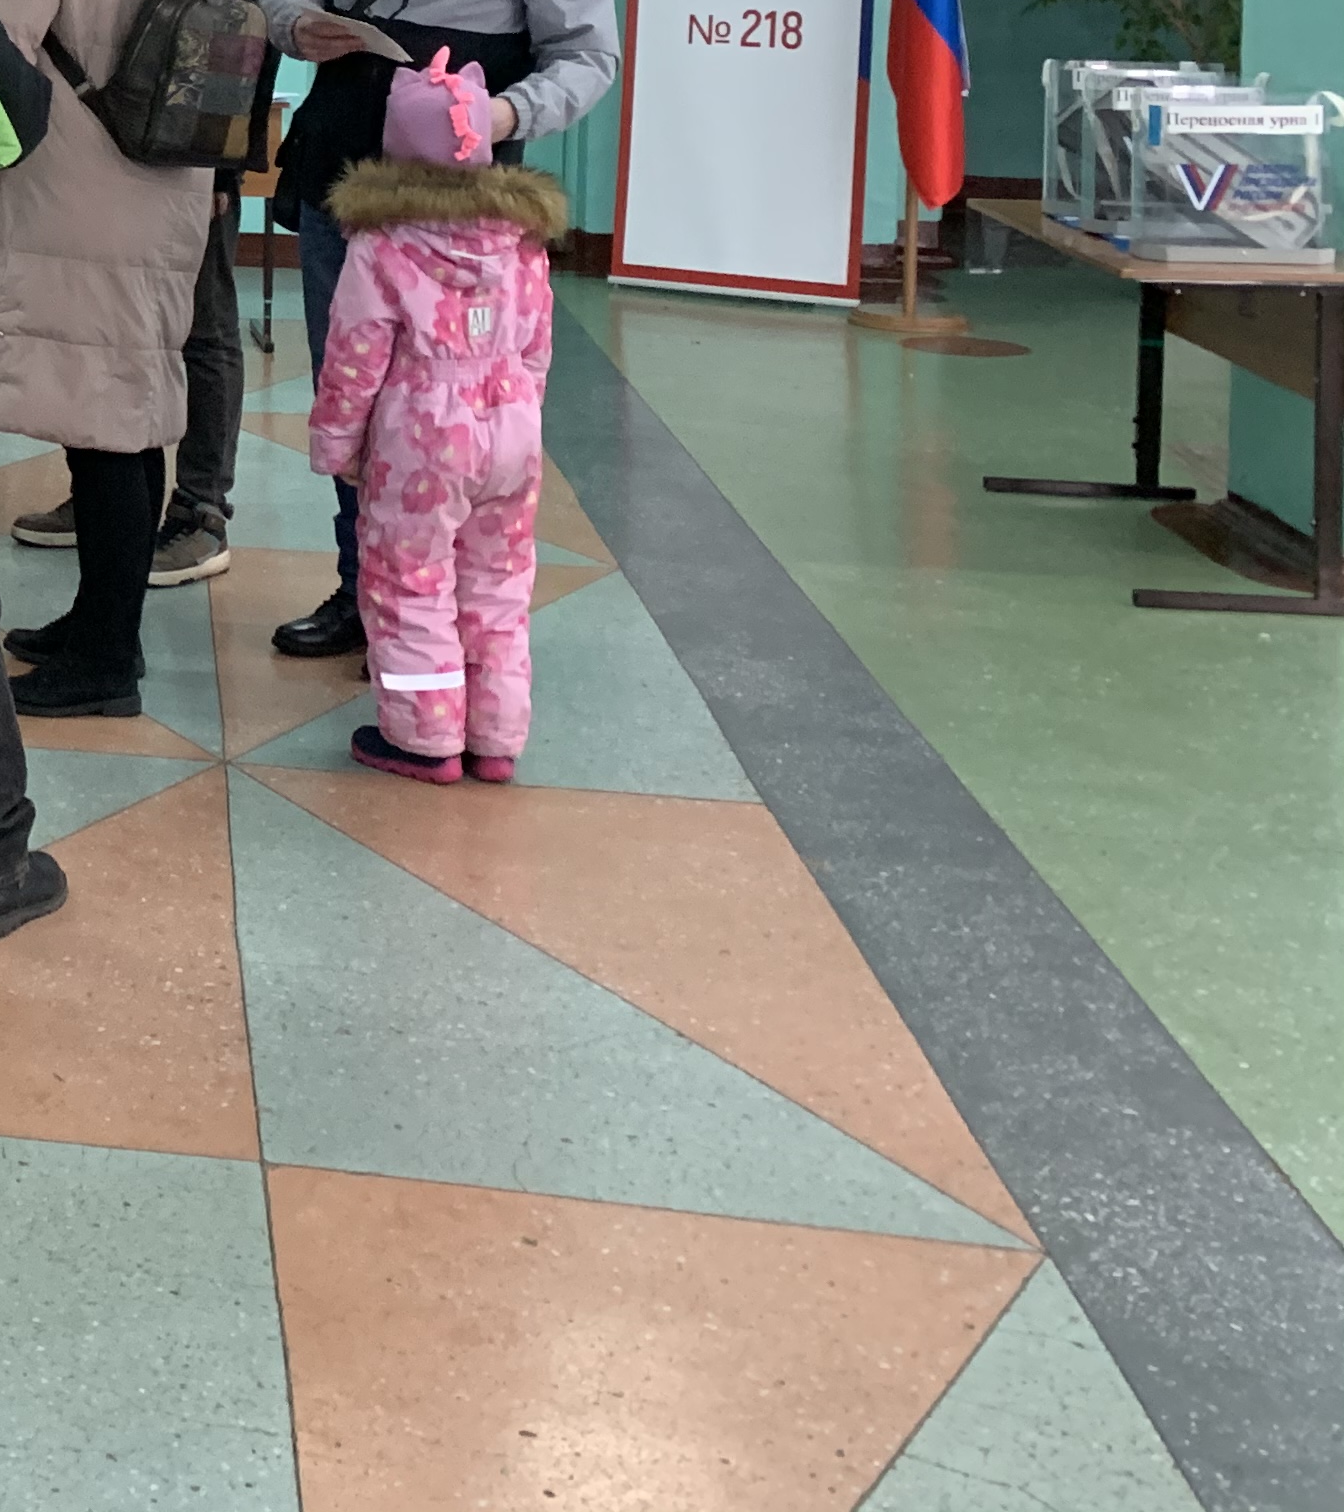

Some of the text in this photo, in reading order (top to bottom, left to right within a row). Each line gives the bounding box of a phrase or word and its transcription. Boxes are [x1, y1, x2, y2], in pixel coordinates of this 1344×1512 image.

[687, 9, 804, 50] № 218
[1269, 113, 1308, 129] урна
